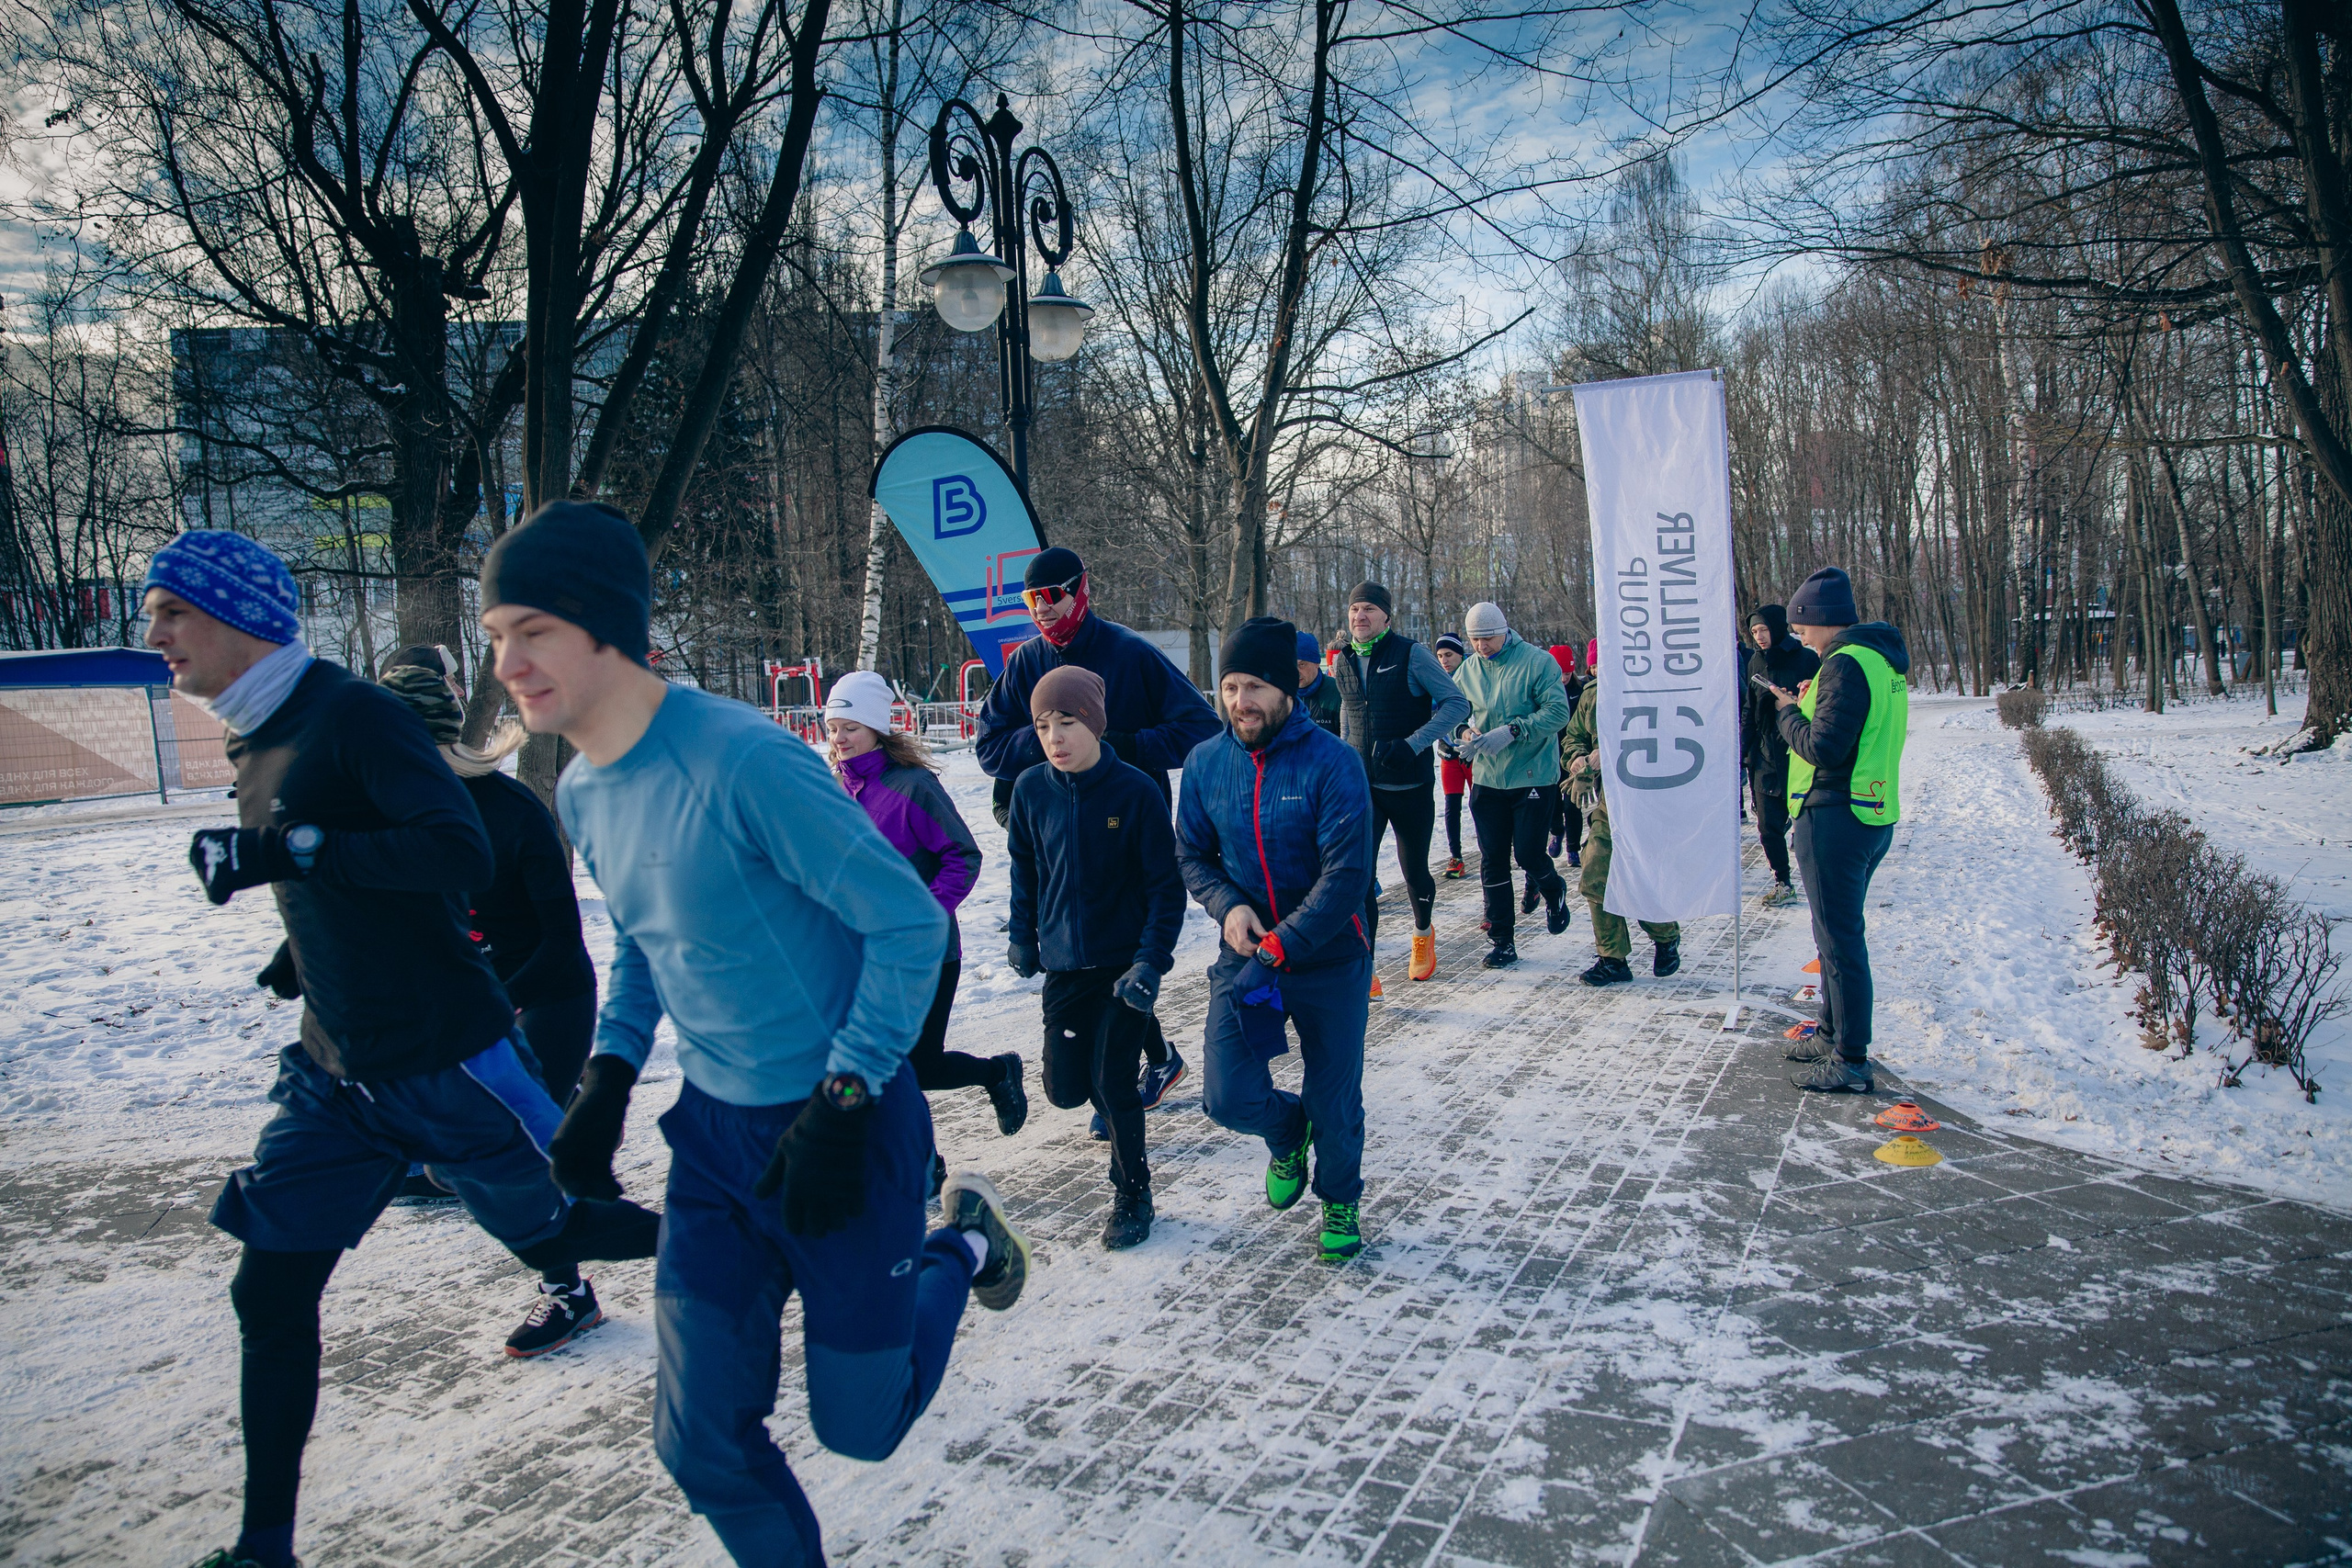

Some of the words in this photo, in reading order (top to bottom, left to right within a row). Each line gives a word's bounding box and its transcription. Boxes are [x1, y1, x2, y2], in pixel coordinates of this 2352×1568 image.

[186, 760, 211, 770] ВДНХ
[211, 758, 229, 768] ДЛЯ
[32, 770, 56, 782] ДЛЯ
[59, 767, 89, 778] ВСЕХ
[214, 769, 231, 779] ДЛЯ
[34, 783, 57, 793] ДЛЯ
[60, 777, 115, 790] КАЖДОГО
